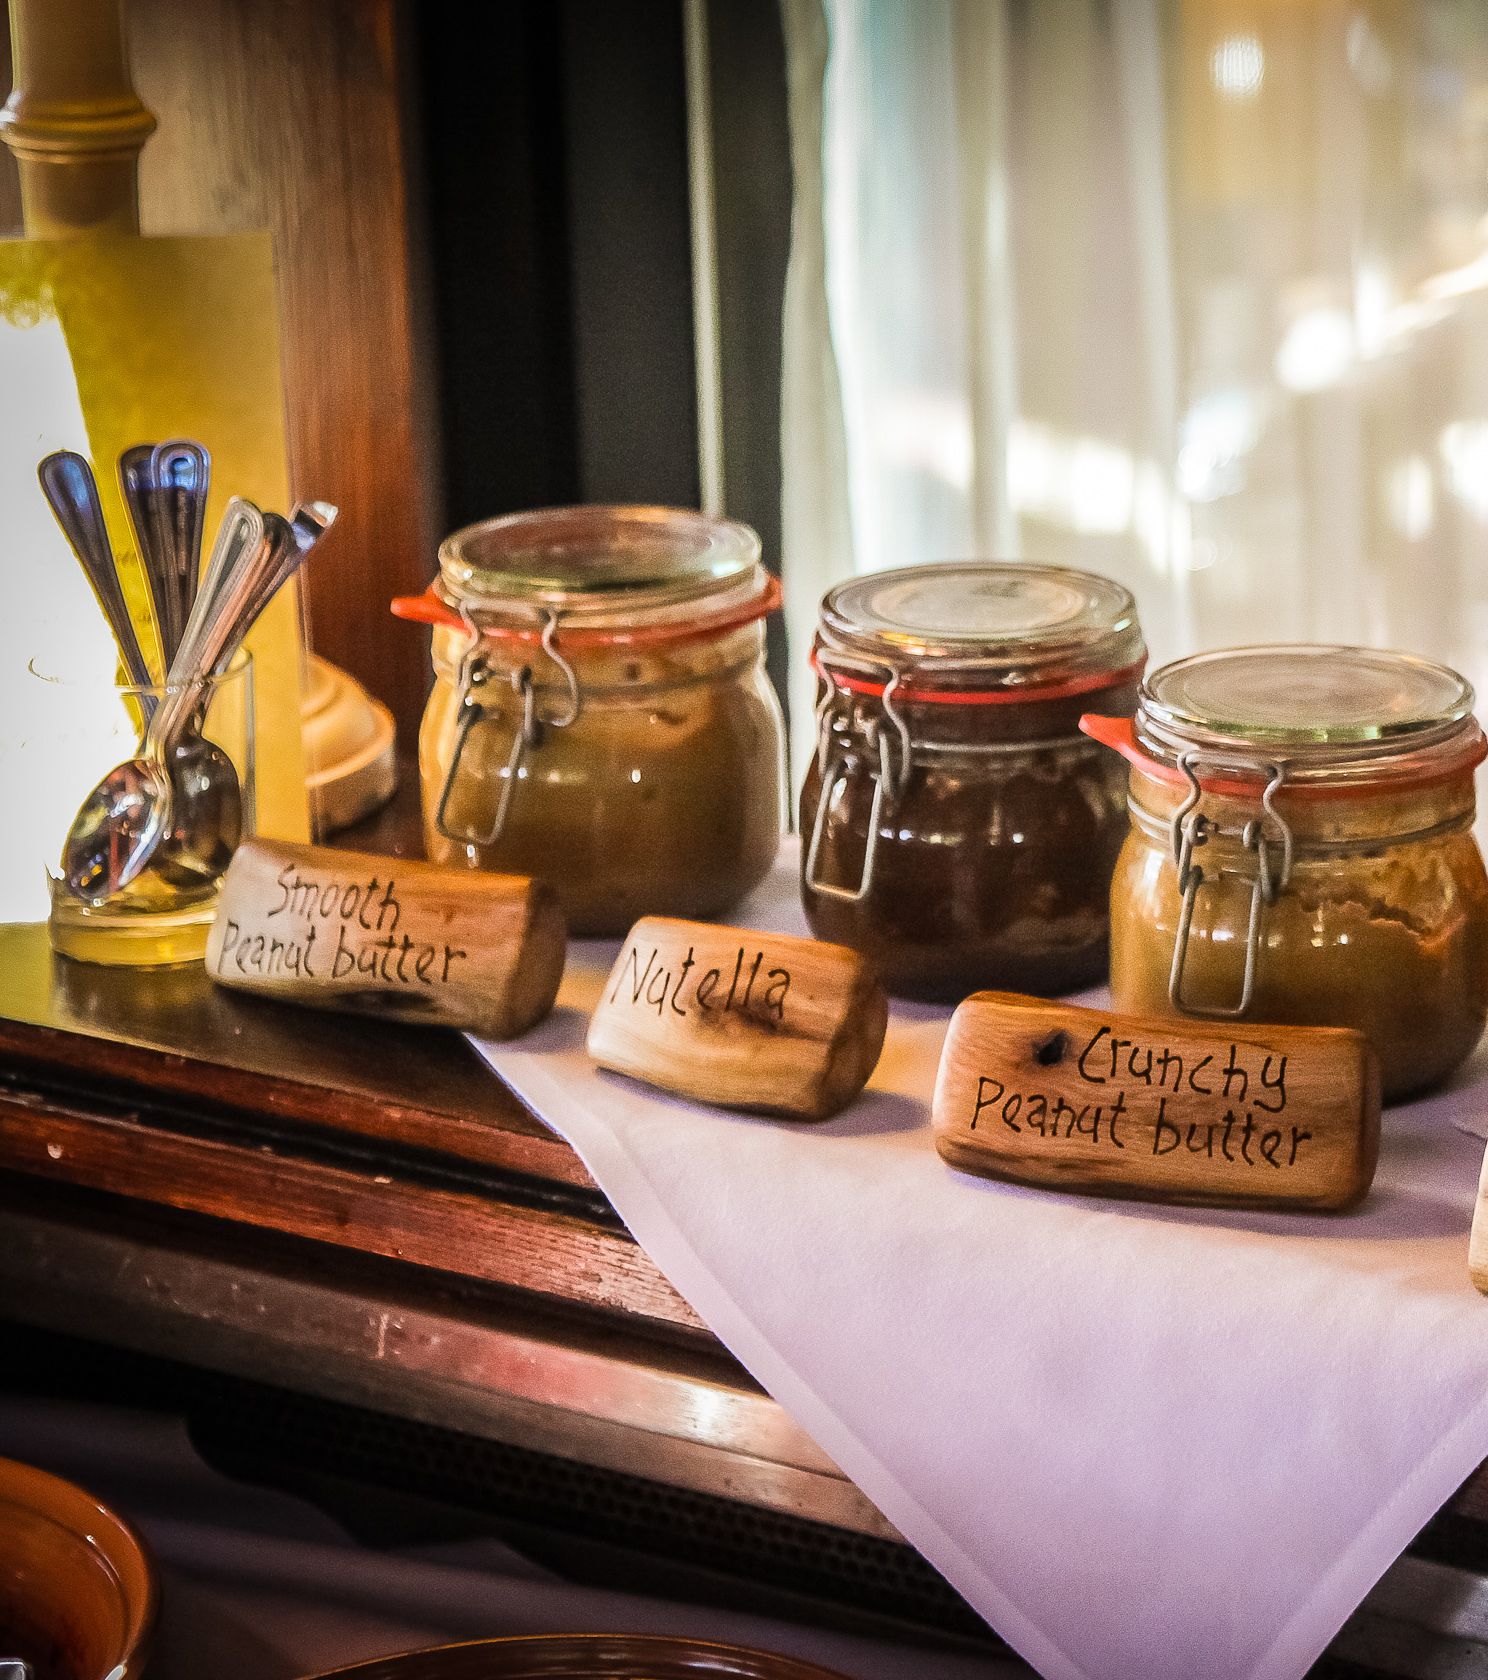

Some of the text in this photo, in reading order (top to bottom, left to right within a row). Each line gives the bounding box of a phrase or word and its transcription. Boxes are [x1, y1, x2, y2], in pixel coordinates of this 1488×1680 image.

[267, 863, 402, 932] Smooth
[216, 918, 468, 986] Peanut butter
[609, 946, 791, 1020] Nutella
[1077, 1026, 1288, 1114] Crunchy
[970, 1076, 1313, 1169] Peanut butter
